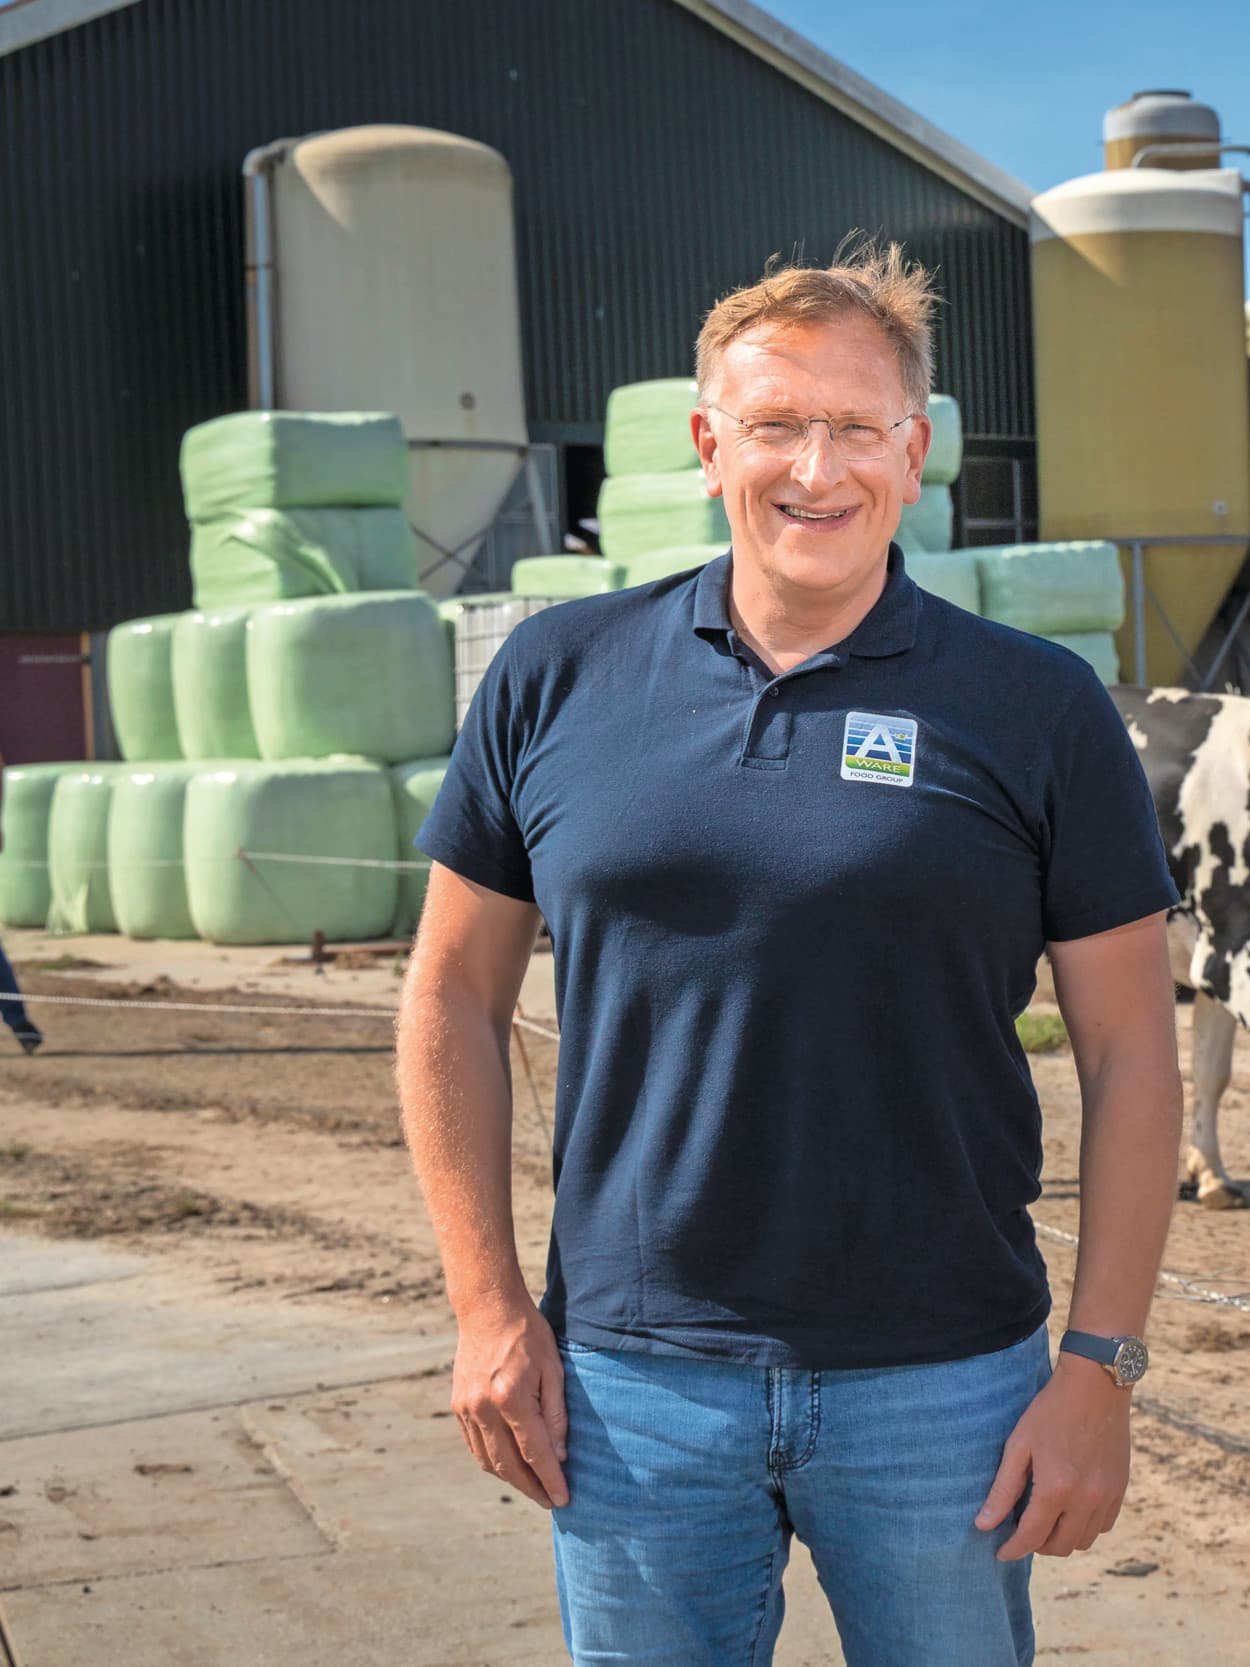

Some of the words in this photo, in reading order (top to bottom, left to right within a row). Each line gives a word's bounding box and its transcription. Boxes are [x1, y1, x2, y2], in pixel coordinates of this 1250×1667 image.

[854, 724, 903, 763] A
[855, 760, 901, 773] WARE
[850, 771, 874, 779] FOOD
[876, 774, 904, 783] GROUP
